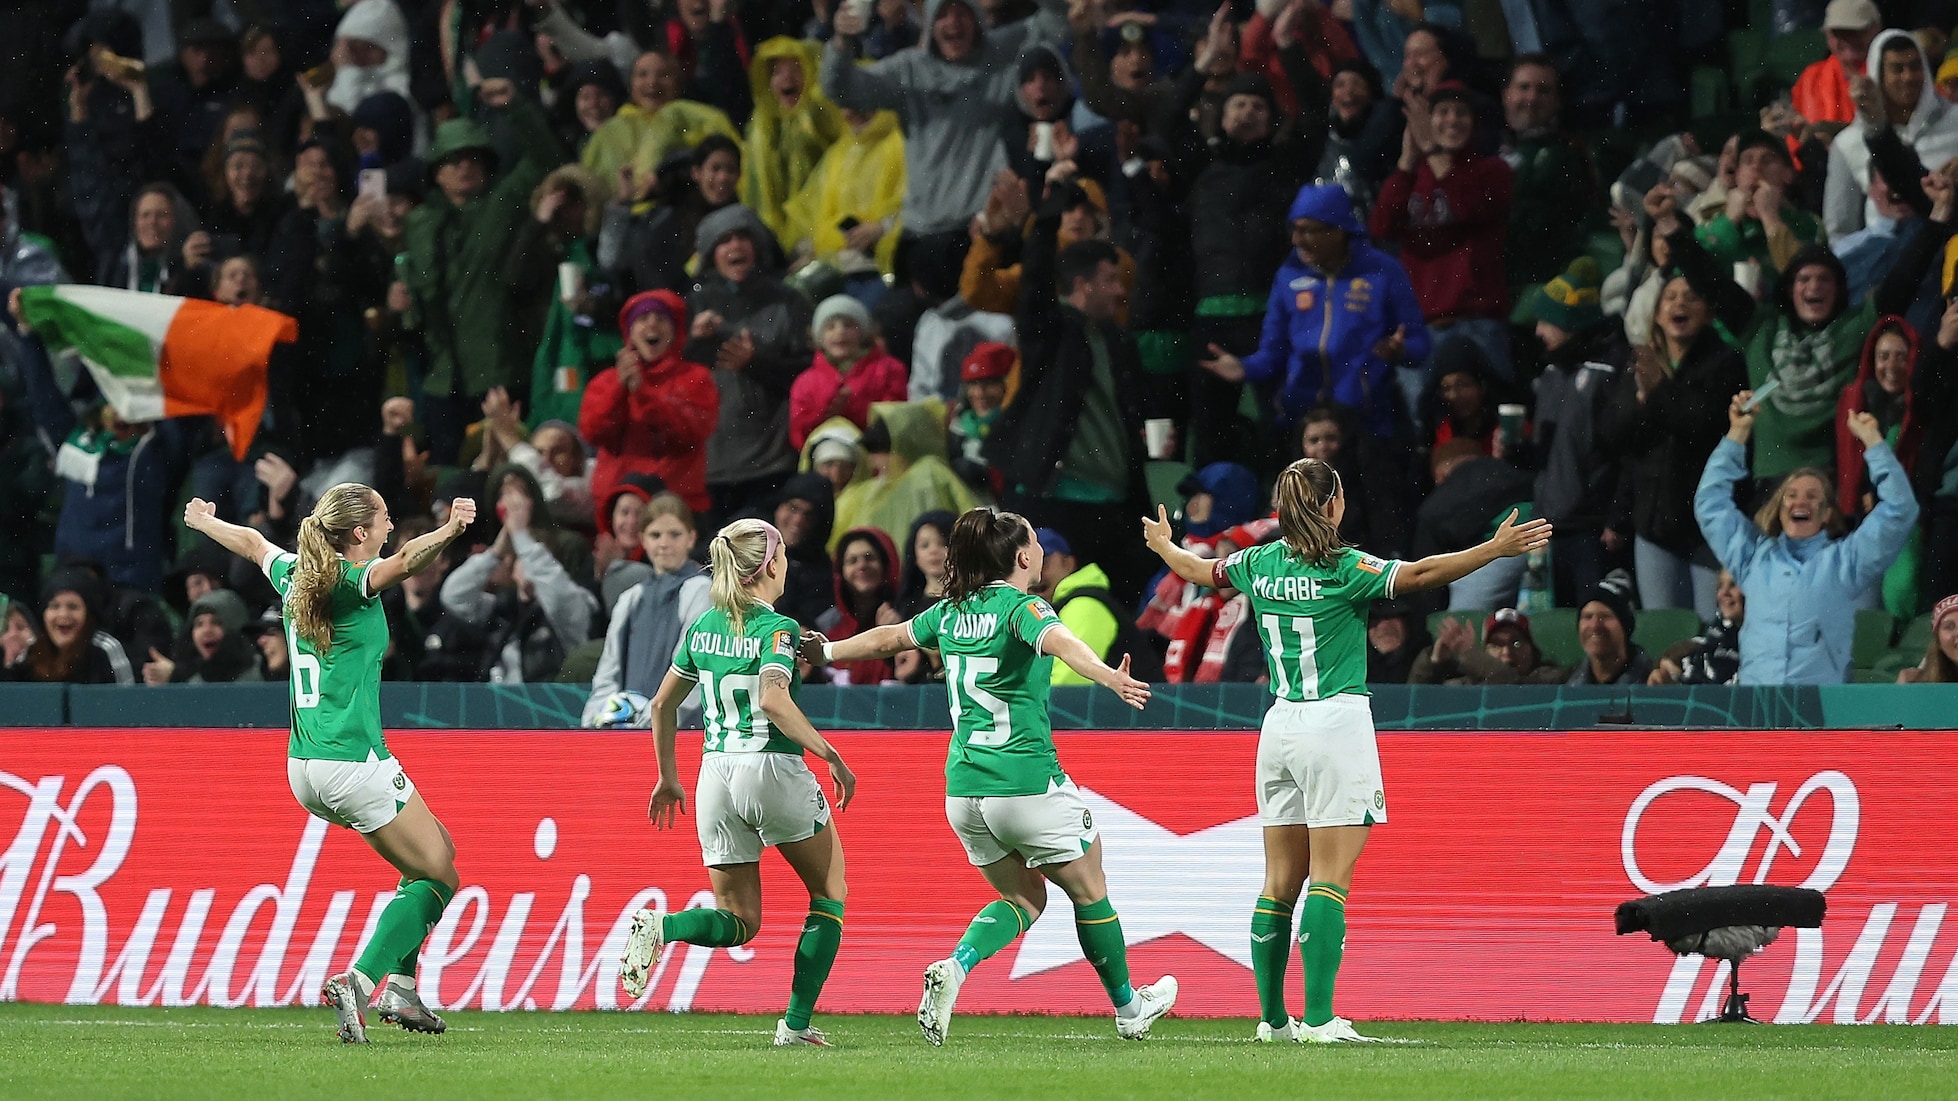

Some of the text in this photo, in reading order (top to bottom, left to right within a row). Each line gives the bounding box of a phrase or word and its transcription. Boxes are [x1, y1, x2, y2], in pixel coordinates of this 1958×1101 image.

[953, 612, 998, 640] QUINN
[1252, 574, 1325, 601] McCABE
[289, 619, 321, 708] 6
[945, 654, 1012, 746] 15
[1261, 614, 1319, 700] 11
[698, 669, 770, 753] 10
[1620, 769, 1958, 1025] Bu
